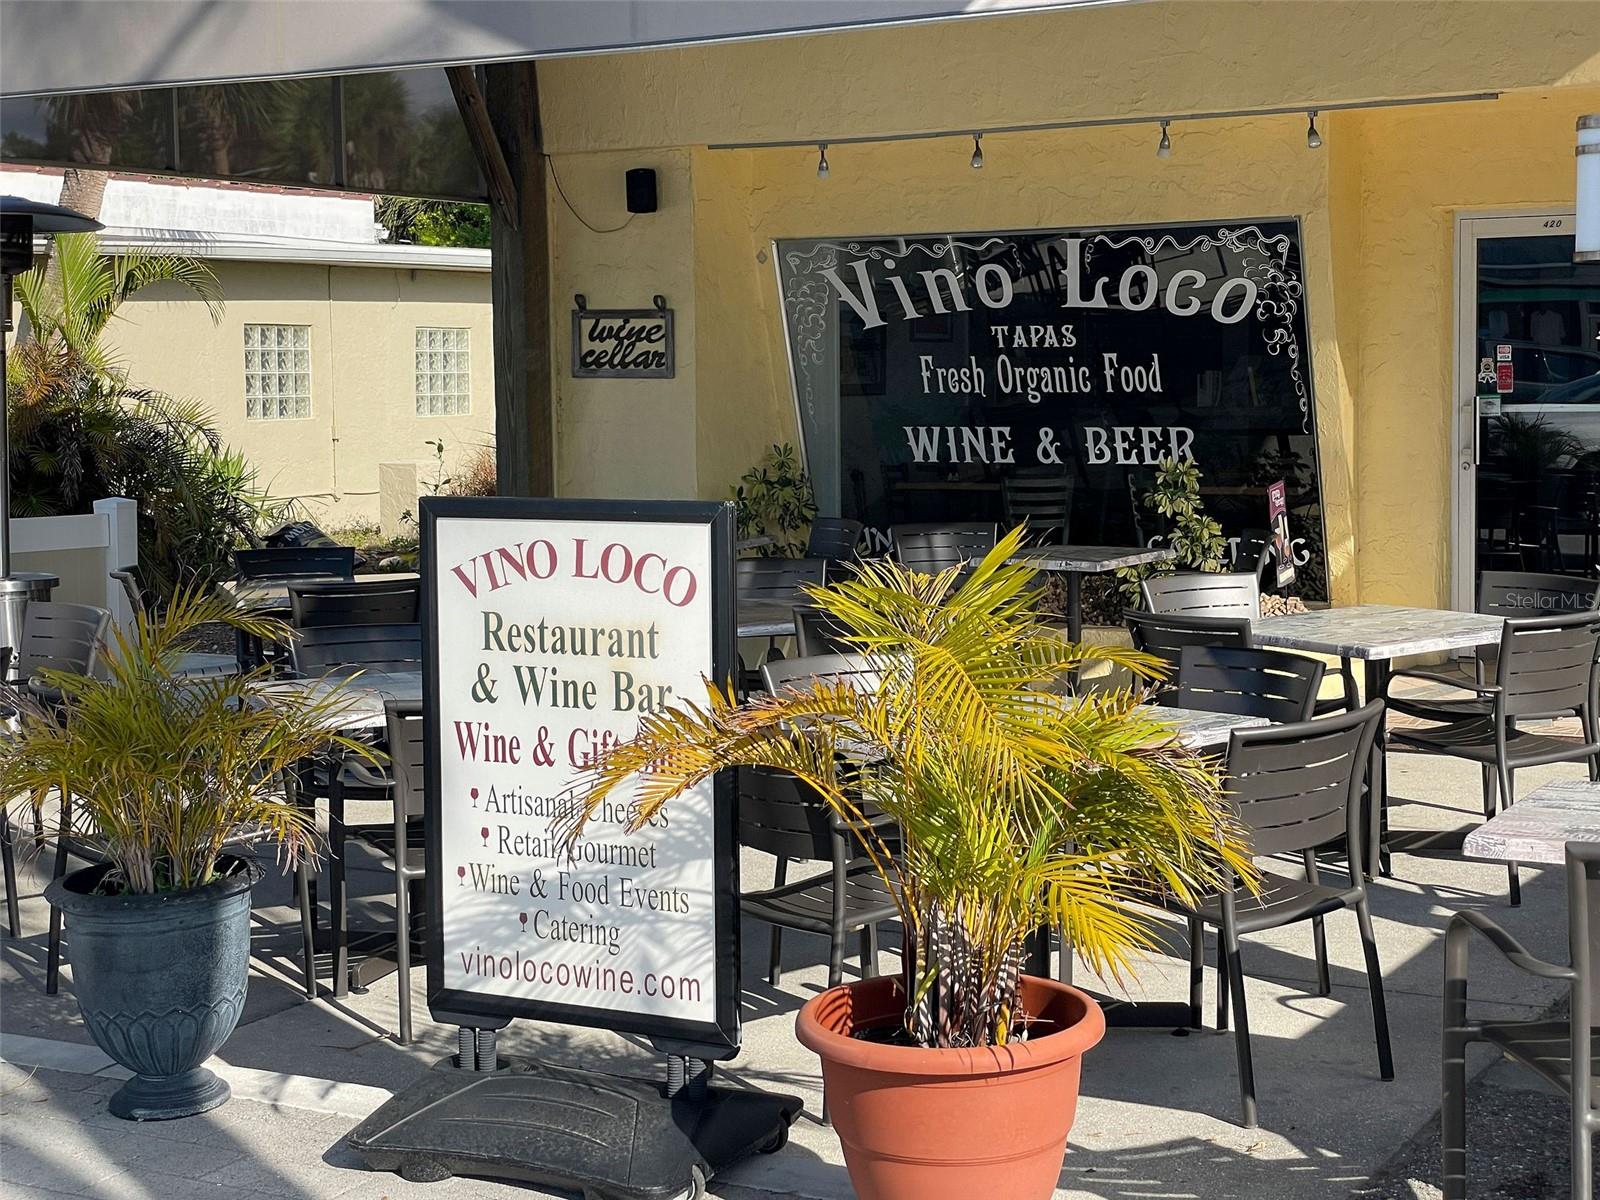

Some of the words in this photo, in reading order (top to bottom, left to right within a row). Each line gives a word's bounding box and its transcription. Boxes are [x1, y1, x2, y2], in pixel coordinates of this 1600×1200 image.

[1543, 220, 1562, 229] 420
[816, 254, 1014, 330] Vino
[1060, 237, 1258, 324] Loco
[588, 318, 666, 343] wine
[990, 325, 1077, 348] TAPAS
[581, 340, 666, 369] cellar
[919, 355, 986, 398] Fresh
[997, 355, 1091, 403] Organic
[1103, 353, 1163, 393] Food
[904, 426, 1014, 464] WINE
[1036, 429, 1063, 465] &
[1085, 426, 1197, 466] BEER
[450, 538, 558, 599] VINO
[571, 538, 697, 607] LOCO
[481, 611, 659, 659] Restaurant
[471, 663, 499, 704] &
[513, 665, 597, 711] Wine
[611, 670, 673, 714] Bar
[453, 720, 521, 765] Wine
[532, 725, 556, 767] &
[485, 784, 575, 820] Artisanal
[497, 825, 557, 859] Retail
[468, 863, 520, 896] Wine
[529, 868, 549, 899] &
[558, 871, 609, 905] Food
[619, 877, 690, 914] Events
[534, 909, 621, 956] Catering
[460, 946, 701, 1002] vinolocowine.com
